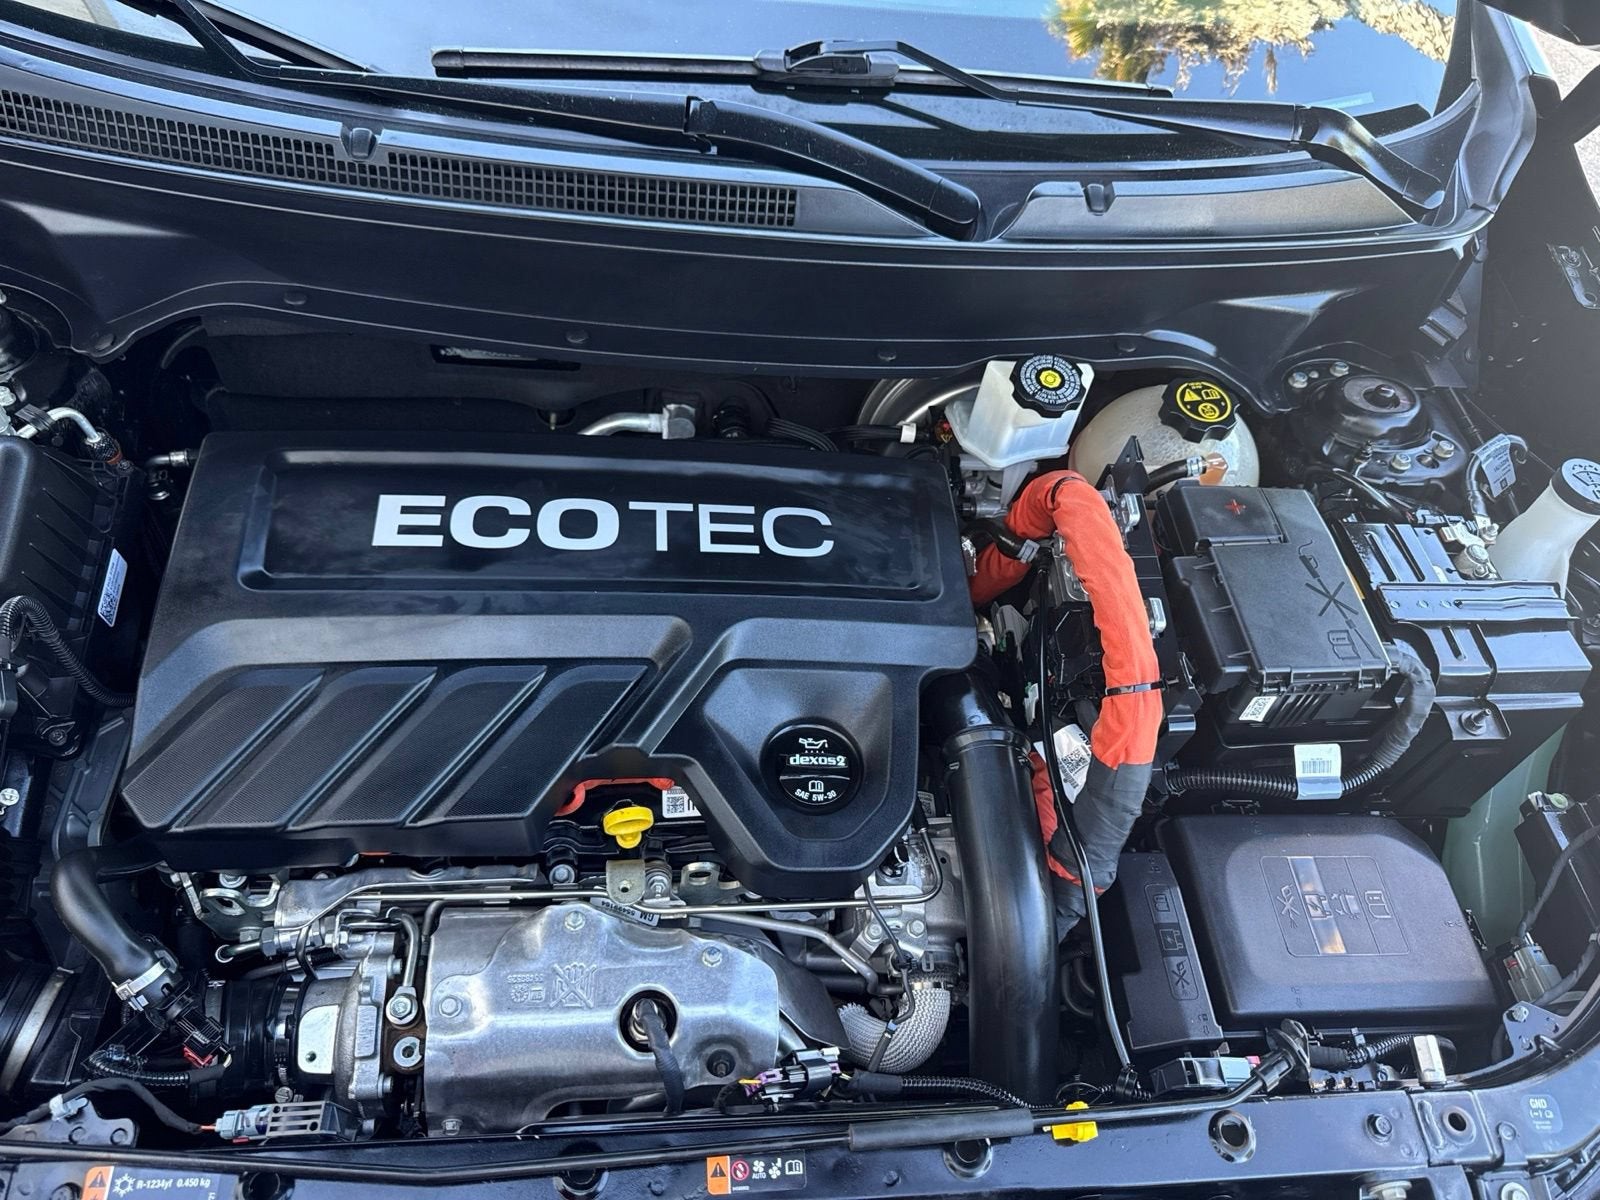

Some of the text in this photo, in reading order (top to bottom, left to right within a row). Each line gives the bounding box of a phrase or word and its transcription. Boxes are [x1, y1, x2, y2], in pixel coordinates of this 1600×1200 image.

[371, 494, 836, 558] ECOTEC
[789, 754, 846, 766] dexos2
[794, 788, 837, 801] SAE 5W-30
[1529, 1098, 1548, 1109] GND
[136, 1177, 211, 1190] R-1234yf 0.450 kg
